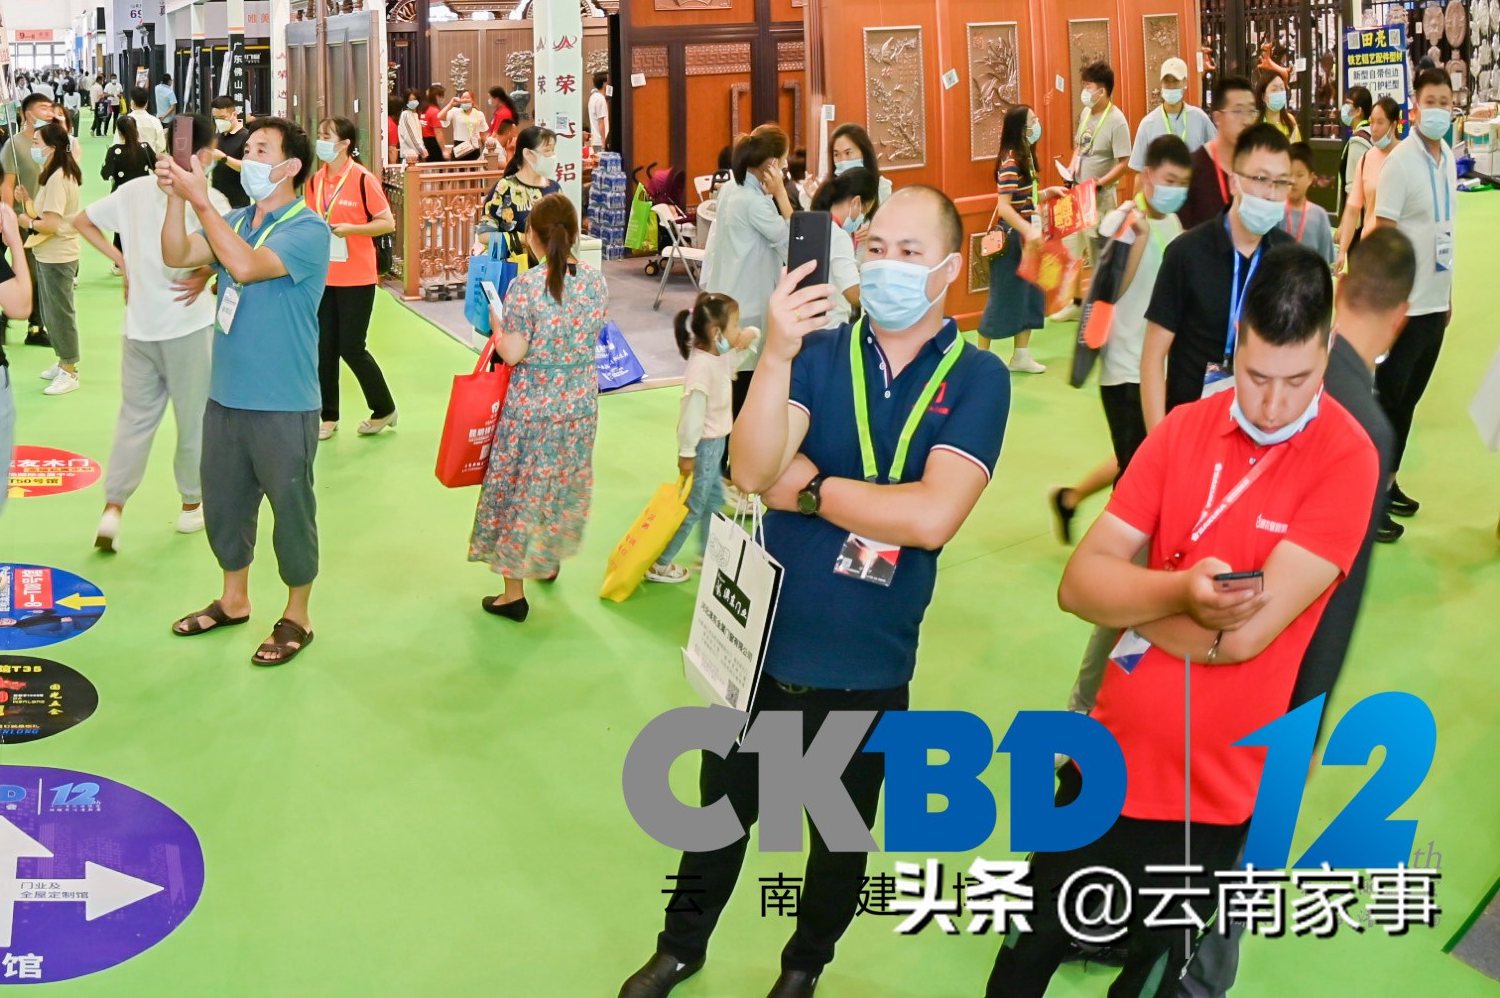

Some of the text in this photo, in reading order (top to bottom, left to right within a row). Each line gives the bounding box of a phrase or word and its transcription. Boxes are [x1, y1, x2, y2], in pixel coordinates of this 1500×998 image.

[1361, 29, 1388, 49] 田亮
[9, 458, 91, 467] 友木门
[49, 782, 101, 805] 12
[20, 881, 61, 890] 门业及
[20, 890, 89, 899] 全屋定制馆
